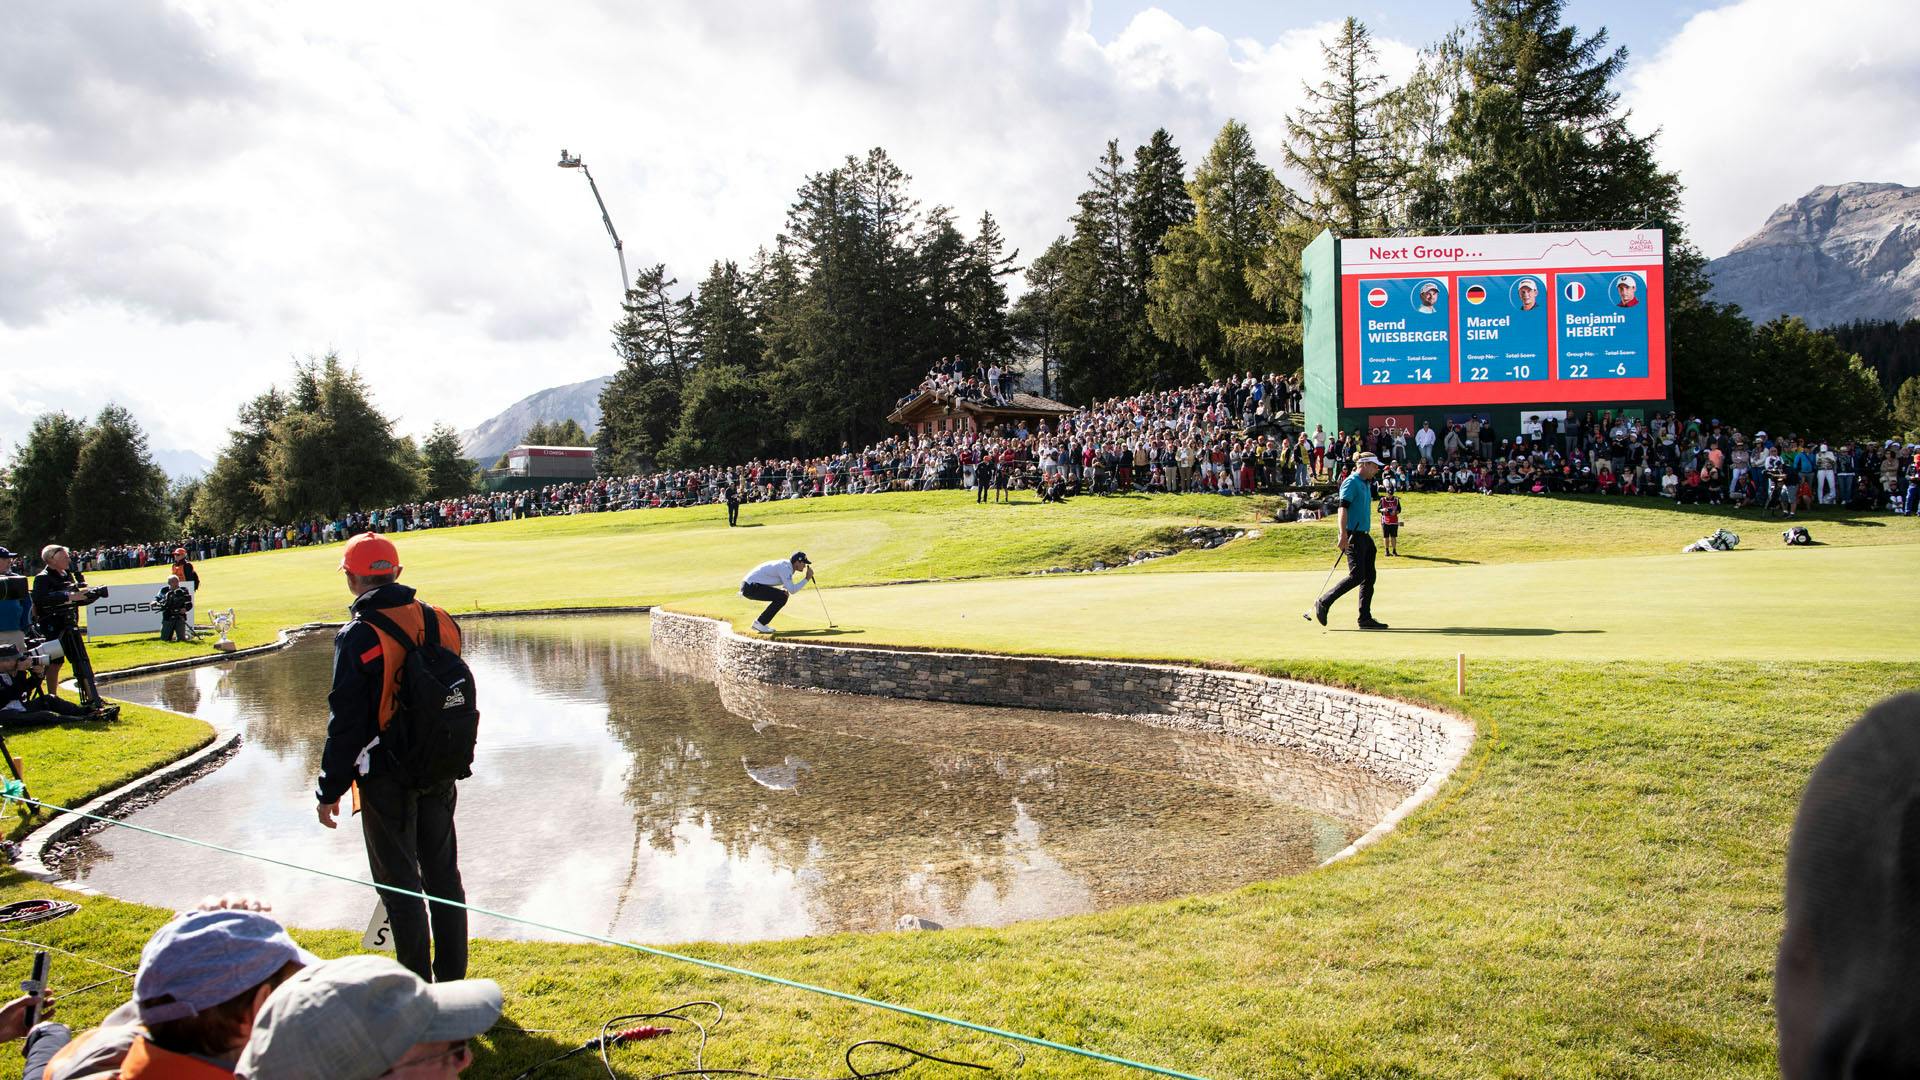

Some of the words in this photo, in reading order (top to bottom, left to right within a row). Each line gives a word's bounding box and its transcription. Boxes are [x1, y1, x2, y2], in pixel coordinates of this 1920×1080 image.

[1369, 247, 1408, 259] Next
[1413, 245, 1482, 262] Group...
[1368, 318, 1406, 331] Bernd
[1466, 315, 1510, 328] Marcel
[1566, 312, 1625, 327] Benjamin
[1368, 330, 1448, 343] WIESBERGER
[1466, 329, 1498, 341] SIEM
[1566, 326, 1616, 338] HEBERT
[1407, 368, 1432, 381] -14
[1470, 367, 1489, 380] 22
[1505, 365, 1530, 378] -10
[1569, 364, 1588, 378] 22
[1608, 362, 1626, 375] -6
[1372, 370, 1390, 383] 22
[94, 602, 161, 616] PORS
